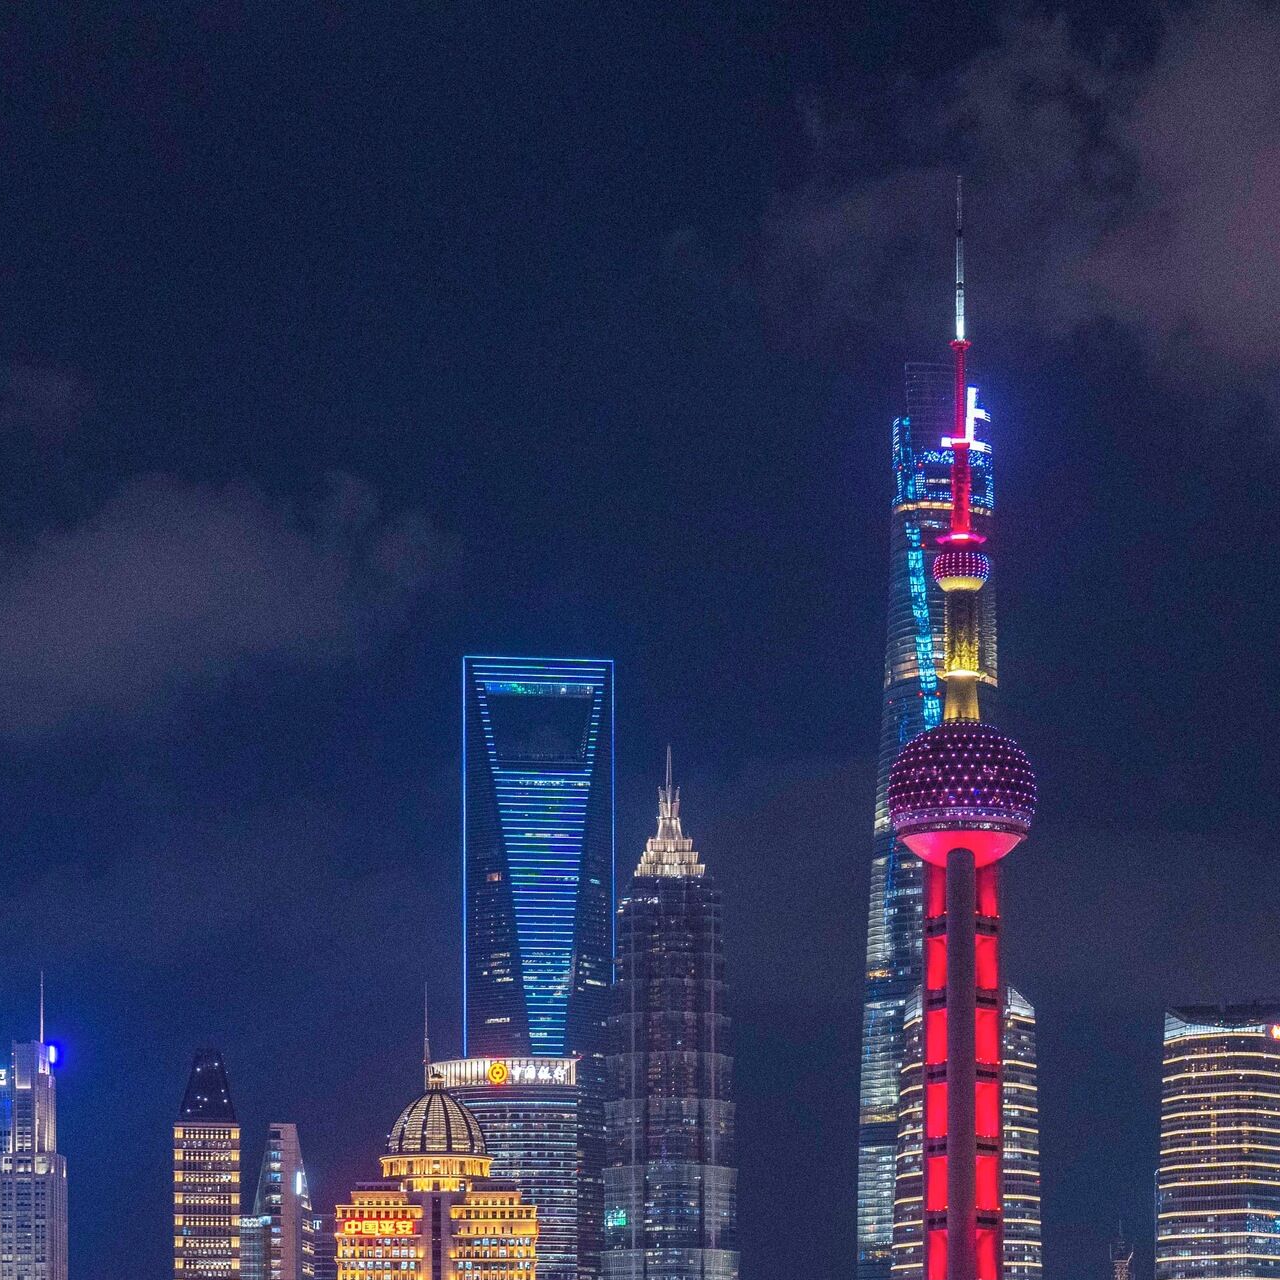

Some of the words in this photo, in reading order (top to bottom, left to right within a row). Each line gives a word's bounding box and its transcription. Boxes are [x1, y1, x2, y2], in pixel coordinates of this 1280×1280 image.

[511, 1064, 570, 1082] 中国银行
[344, 1219, 413, 1235] 中国平安
